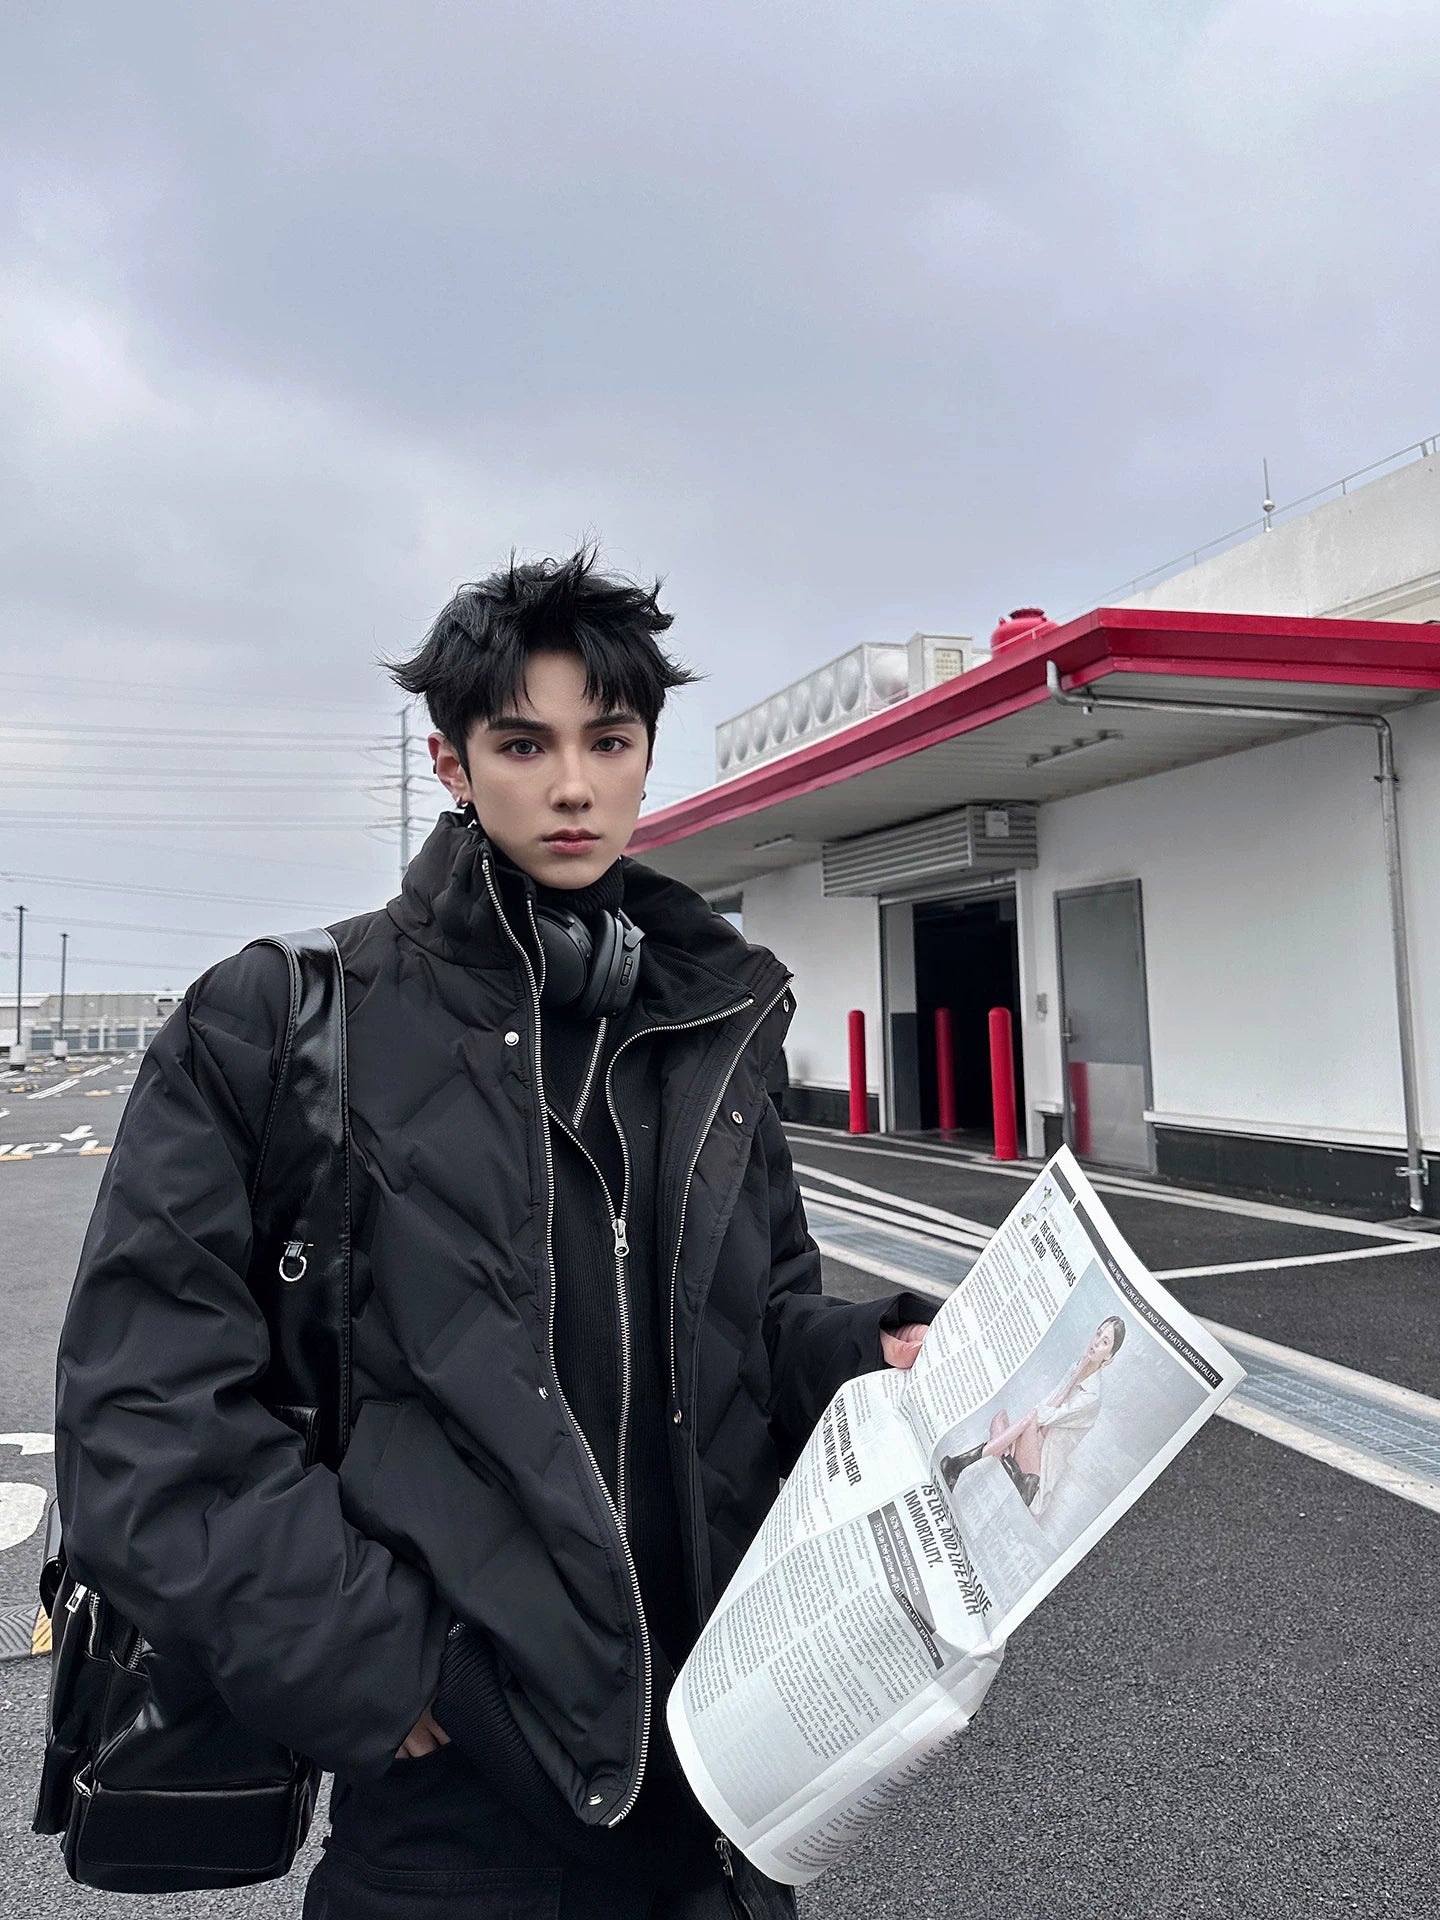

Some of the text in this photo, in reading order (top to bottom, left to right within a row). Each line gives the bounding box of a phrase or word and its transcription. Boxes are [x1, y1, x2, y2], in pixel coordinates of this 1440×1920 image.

[1030, 1233, 1047, 1260] AN END.
[1039, 1220, 1049, 1237] THE
[1044, 1231, 1063, 1262] LONGEST
[1058, 1257, 1069, 1274] DAY
[1064, 1268, 1075, 1286] HAS
[1132, 1295, 1139, 1304] IS
[1145, 1309, 1159, 1324] AND
[1156, 1320, 1170, 1335] LIFE
[1167, 1331, 1184, 1349] HATH
[1181, 1345, 1219, 1385] IMMORTALITY.
[822, 1424, 833, 1445] ONLY
[834, 1393, 861, 1485] I CAN'T CONTROL THEIR
[825, 1443, 835, 1458] MY
[825, 1455, 839, 1482] OWN.
[921, 1483, 935, 1496] IS
[927, 1498, 947, 1527] LIFE.
[874, 1522, 883, 1535] 35%
[903, 1489, 943, 1568] IMMORTALITY.
[938, 1529, 957, 1550] AND
[880, 1542, 890, 1555] their
[889, 1515, 921, 1595] 62% said technology interferes
[883, 1554, 895, 1573] partner
[947, 1554, 966, 1577] LIFE
[891, 1582, 904, 1597] pull
[957, 1580, 980, 1615] HATH
[900, 1596, 912, 1612] out
[910, 1611, 922, 1628] the
[918, 1627, 938, 1659] phone
